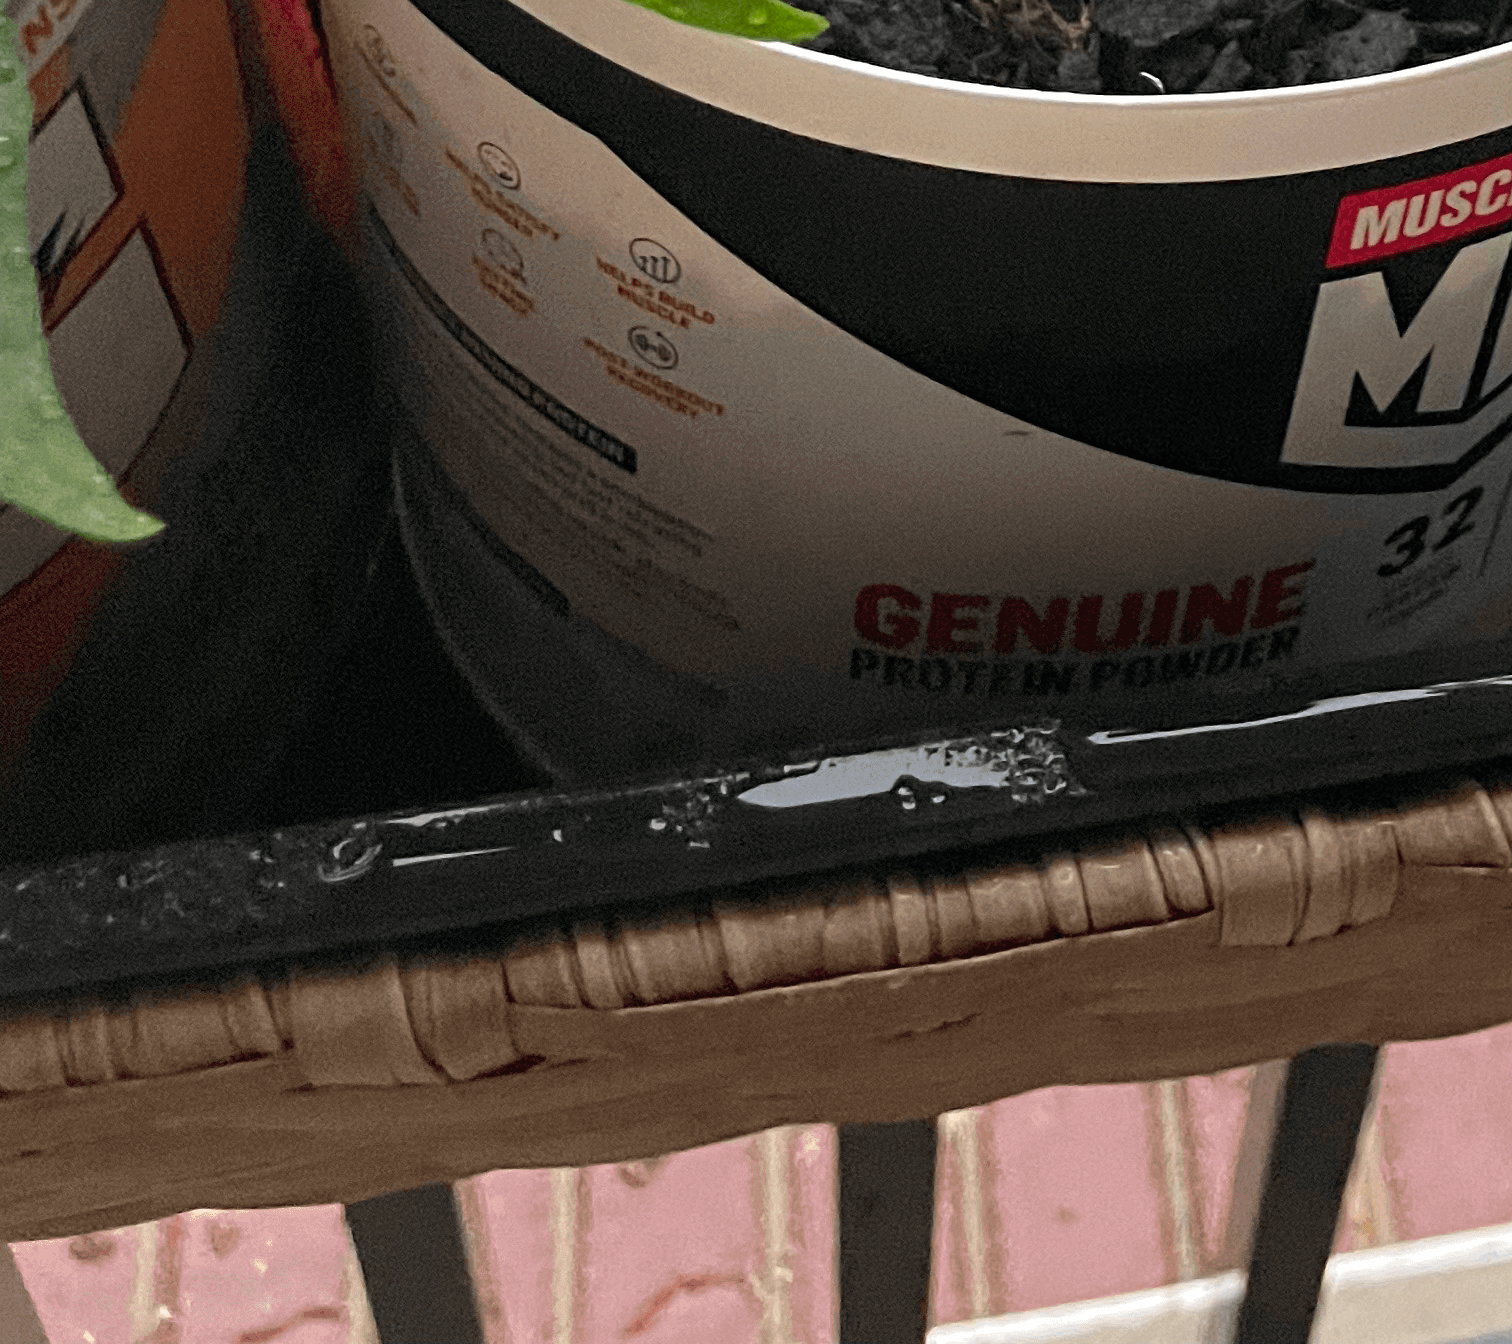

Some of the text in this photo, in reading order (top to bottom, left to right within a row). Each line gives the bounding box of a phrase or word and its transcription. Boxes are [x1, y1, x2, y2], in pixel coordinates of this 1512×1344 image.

[1377, 485, 1485, 579] 32
[853, 557, 1317, 655] GENUINE
[848, 624, 1302, 696] PROTEIN POWDER
